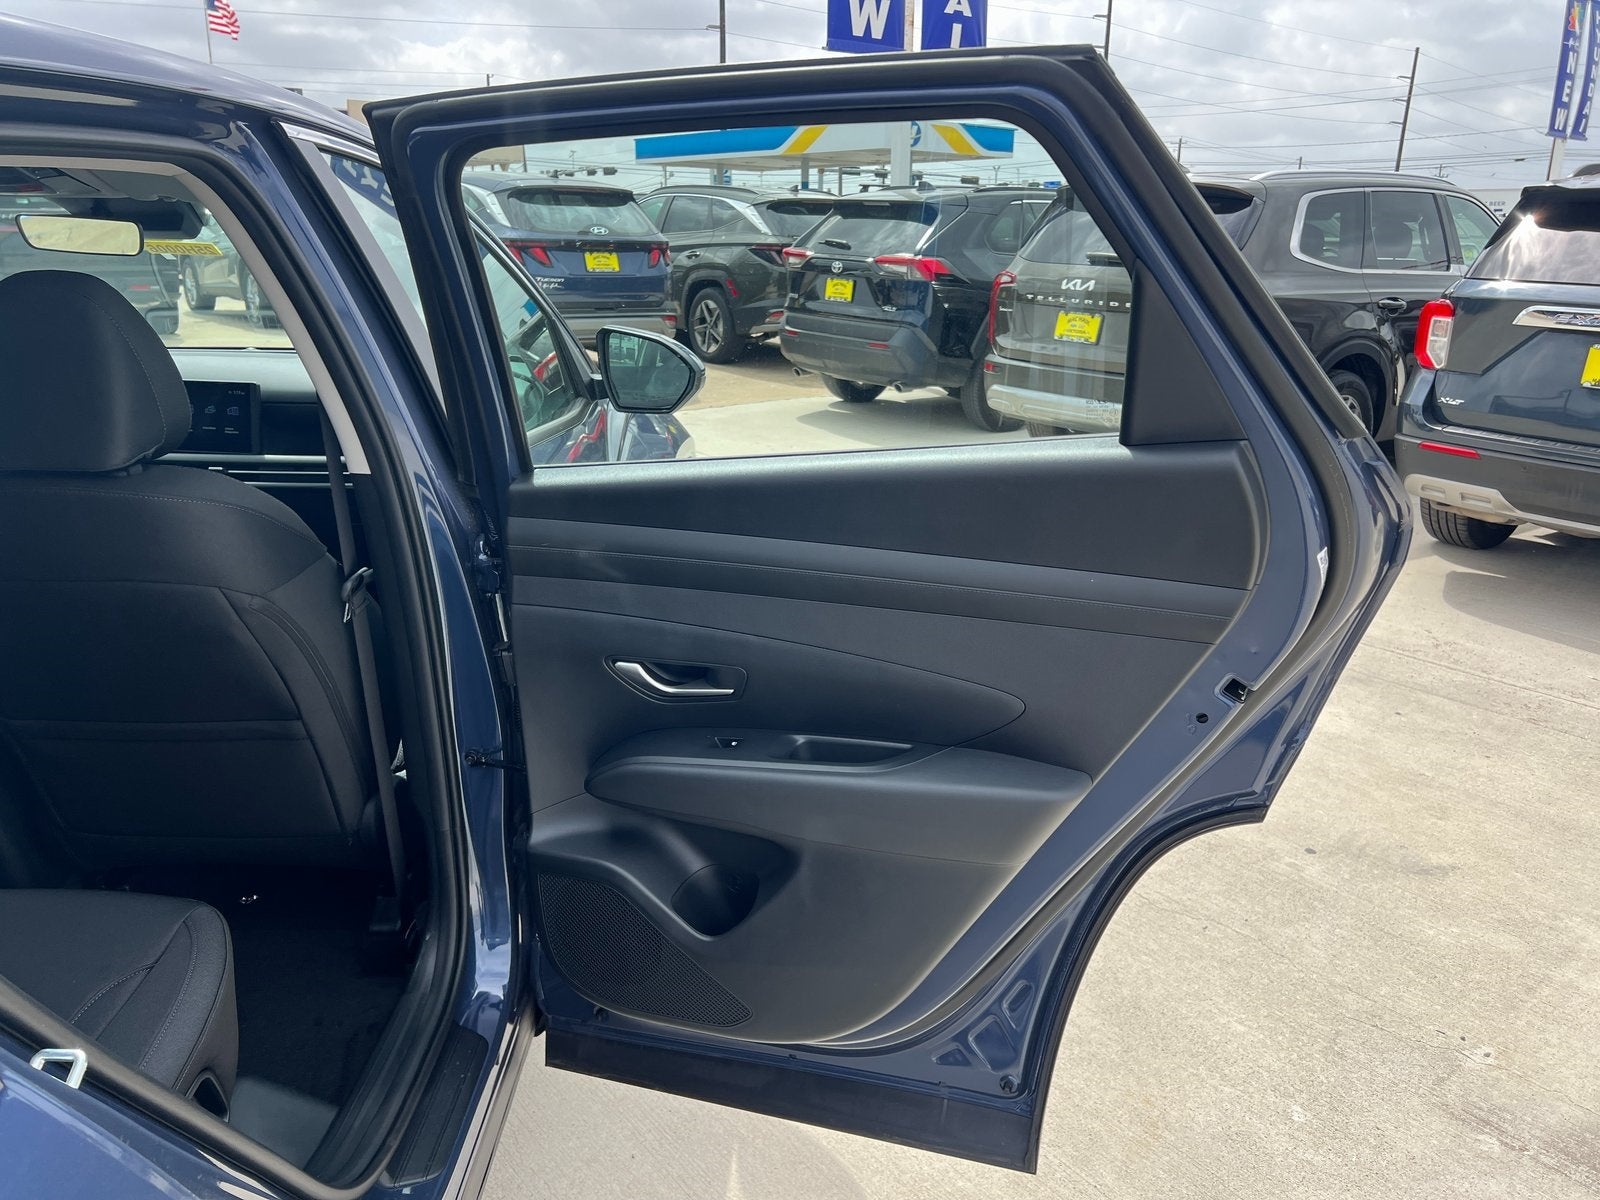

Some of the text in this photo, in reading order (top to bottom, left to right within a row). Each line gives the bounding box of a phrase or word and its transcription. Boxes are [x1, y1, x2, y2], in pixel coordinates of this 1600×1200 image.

[1554, 51, 1577, 130] NEW
[1060, 278, 1096, 291] KIA
[1026, 293, 1132, 308] TELLURIDE
[1437, 397, 1465, 406] XLT
